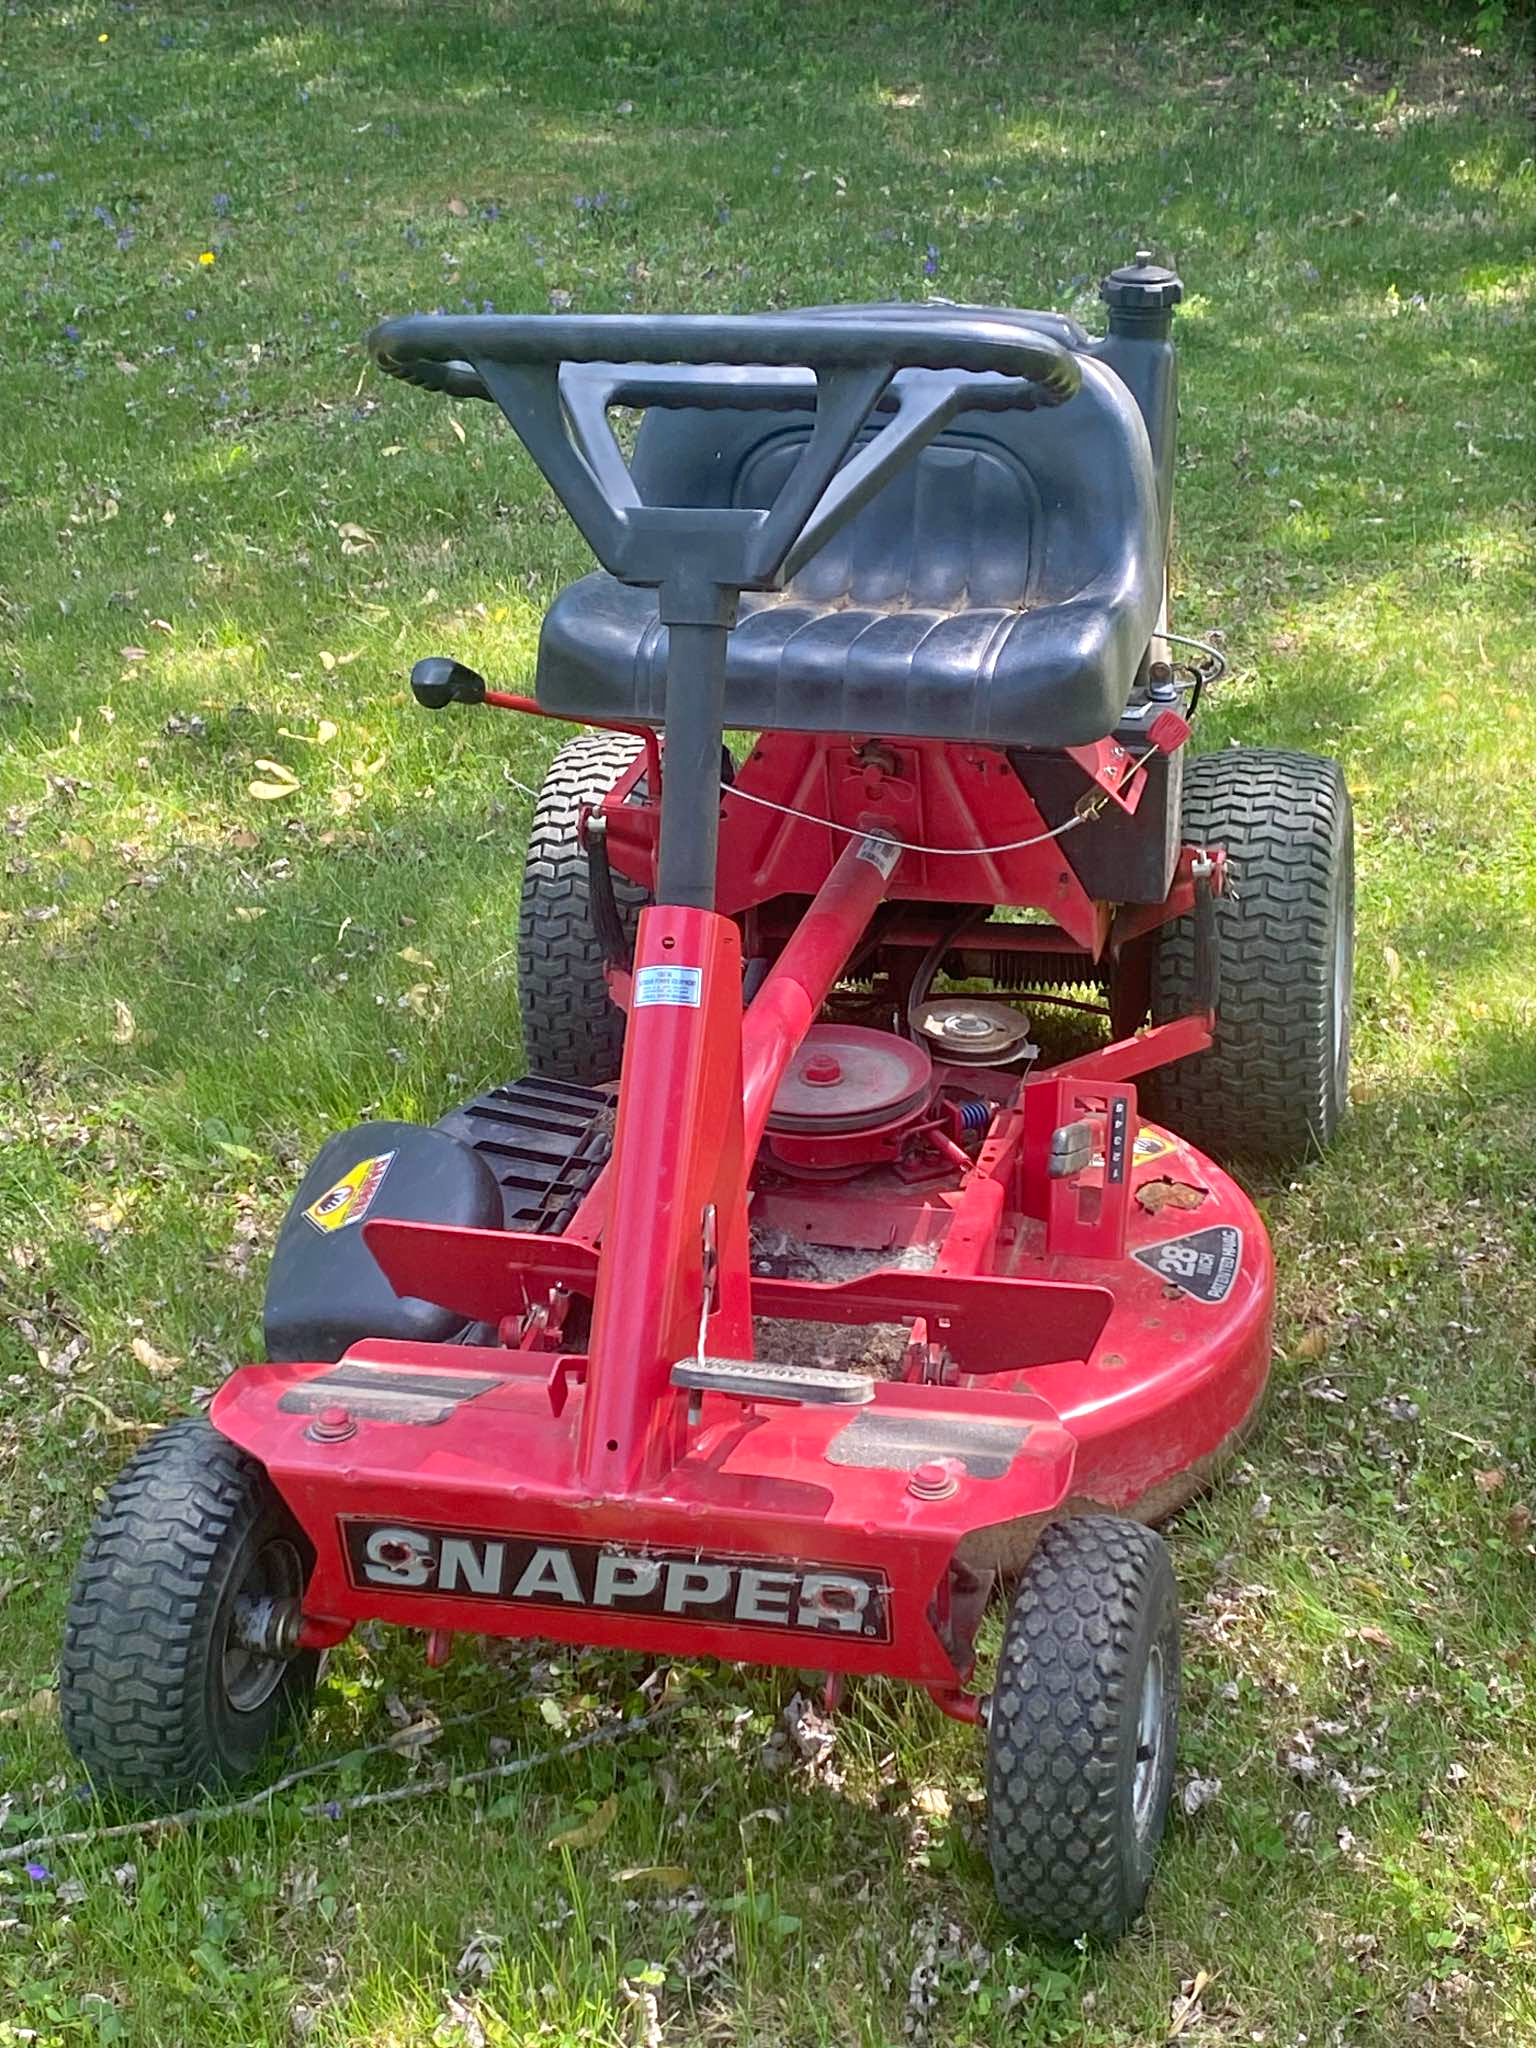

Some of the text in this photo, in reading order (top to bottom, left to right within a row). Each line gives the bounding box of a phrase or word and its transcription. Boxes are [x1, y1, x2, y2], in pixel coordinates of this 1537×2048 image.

[1113, 1136, 1122, 1146] 3
[1112, 1152, 1121, 1162] 2
[1158, 1245, 1198, 1277] 28
[363, 1526, 869, 1633] SNAPPER
